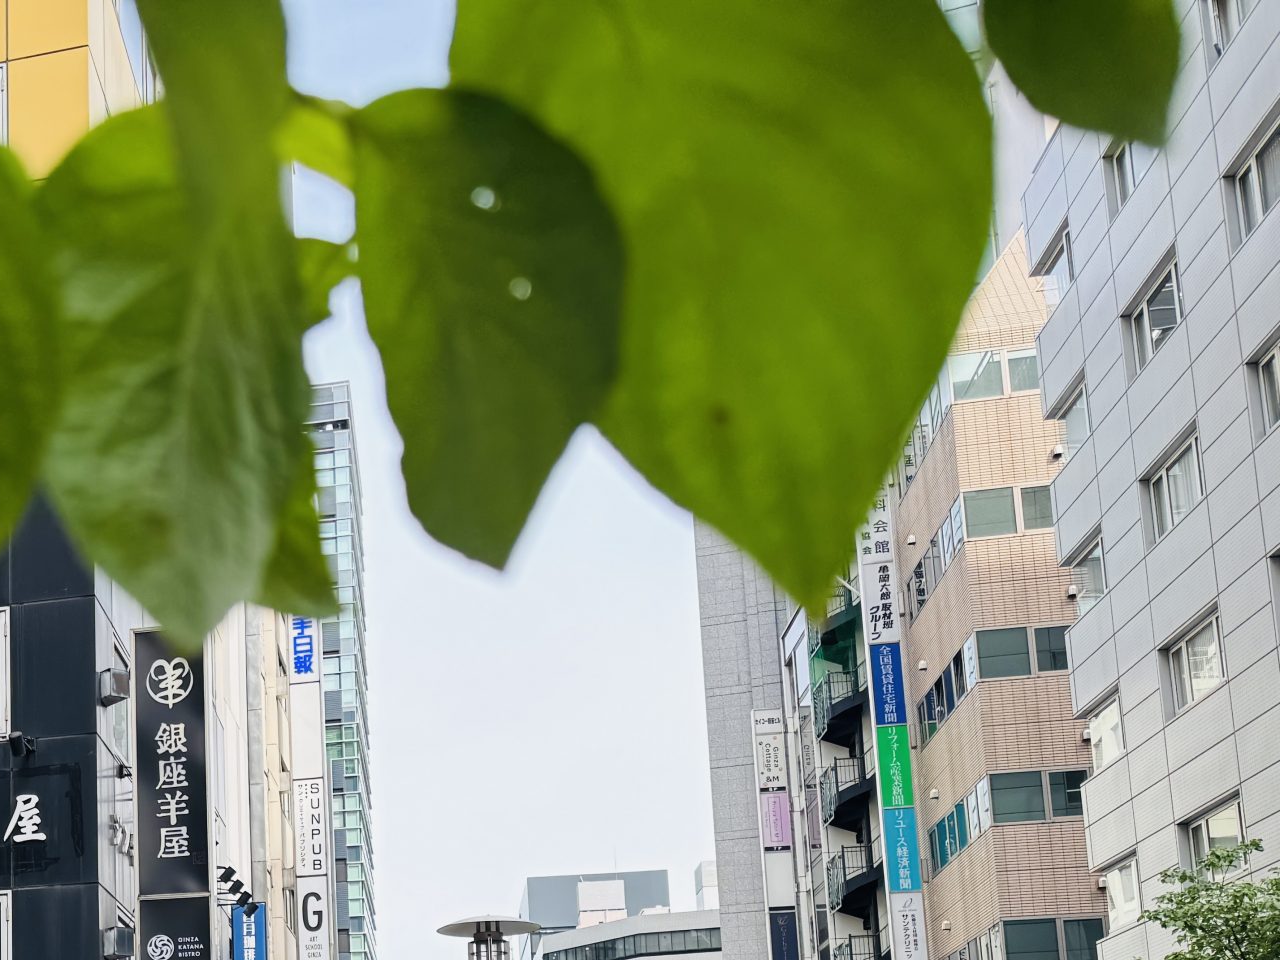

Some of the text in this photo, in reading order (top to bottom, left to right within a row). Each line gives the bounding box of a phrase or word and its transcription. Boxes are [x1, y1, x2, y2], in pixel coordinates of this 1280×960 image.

[870, 605, 882, 641] グループ
[879, 645, 898, 723] 全国賃貸住宅新聞
[154, 722, 191, 859] 銀座羊屋
[888, 726, 904, 805] リフォーム産業新聞
[310, 783, 323, 871] SUNPUB
[895, 810, 911, 889] リユース経済新聞
[302, 892, 323, 932] G
